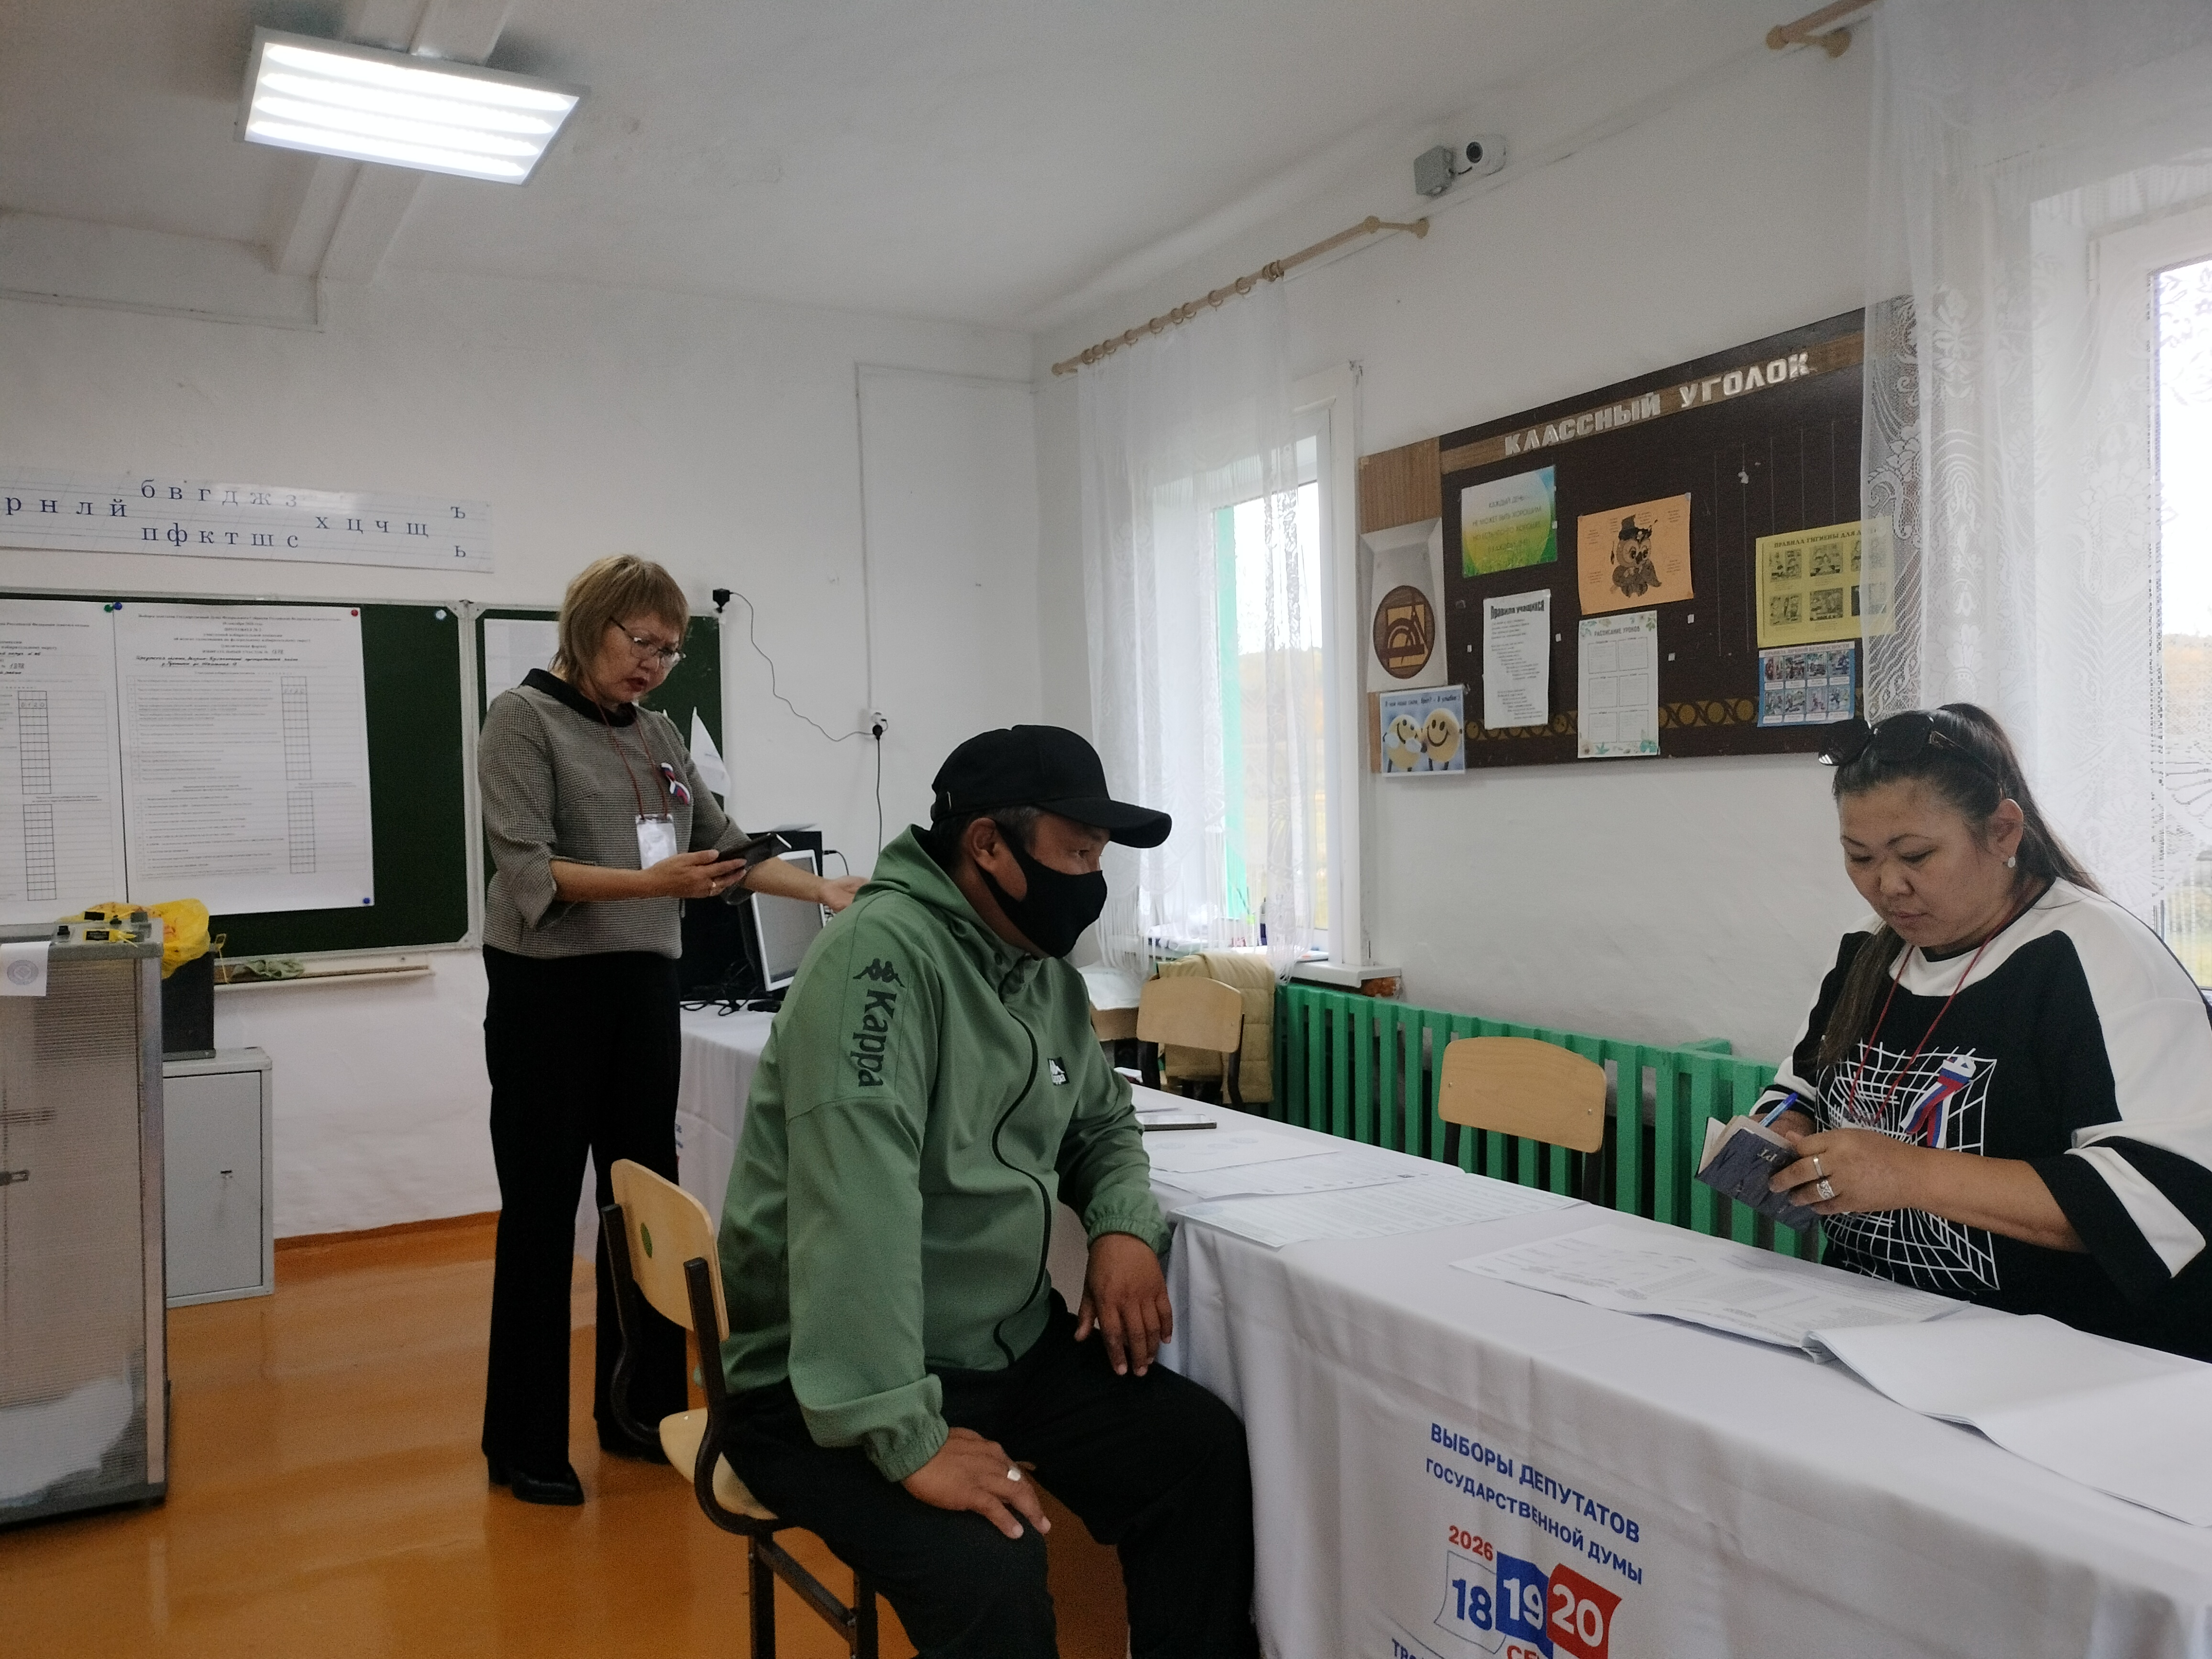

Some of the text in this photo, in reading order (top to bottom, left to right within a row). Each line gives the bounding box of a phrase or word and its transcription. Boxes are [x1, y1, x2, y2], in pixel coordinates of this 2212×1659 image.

[1505, 352, 1810, 455] КЛАССНЫЙ УГОЛОК
[141, 478, 297, 508] б в г д ж з
[5, 497, 128, 518] р н л й
[450, 505, 466, 520] ъ
[141, 522, 299, 549] п ф к т ш с
[315, 516, 429, 538] х ц ч щ
[454, 545, 467, 558] ь
[1774, 539, 1804, 548] ПРАВИЛА
[1807, 534, 1839, 543] ГИГИЕНЫ
[1491, 599, 1544, 619] Правила учащихся
[1594, 628, 1621, 637] РАСПИСАНИЕ
[850, 988, 897, 1087] Kappa
[1431, 1423, 1640, 1543] ВЫБОРЫ ДЕПУТАТОВ
[1426, 1458, 1642, 1585] ГОСУДАРСТВЕННОЙ ДУМЫ
[1448, 1525, 1493, 1561] 2026
[1452, 1578, 1604, 1647] 18 19 20
